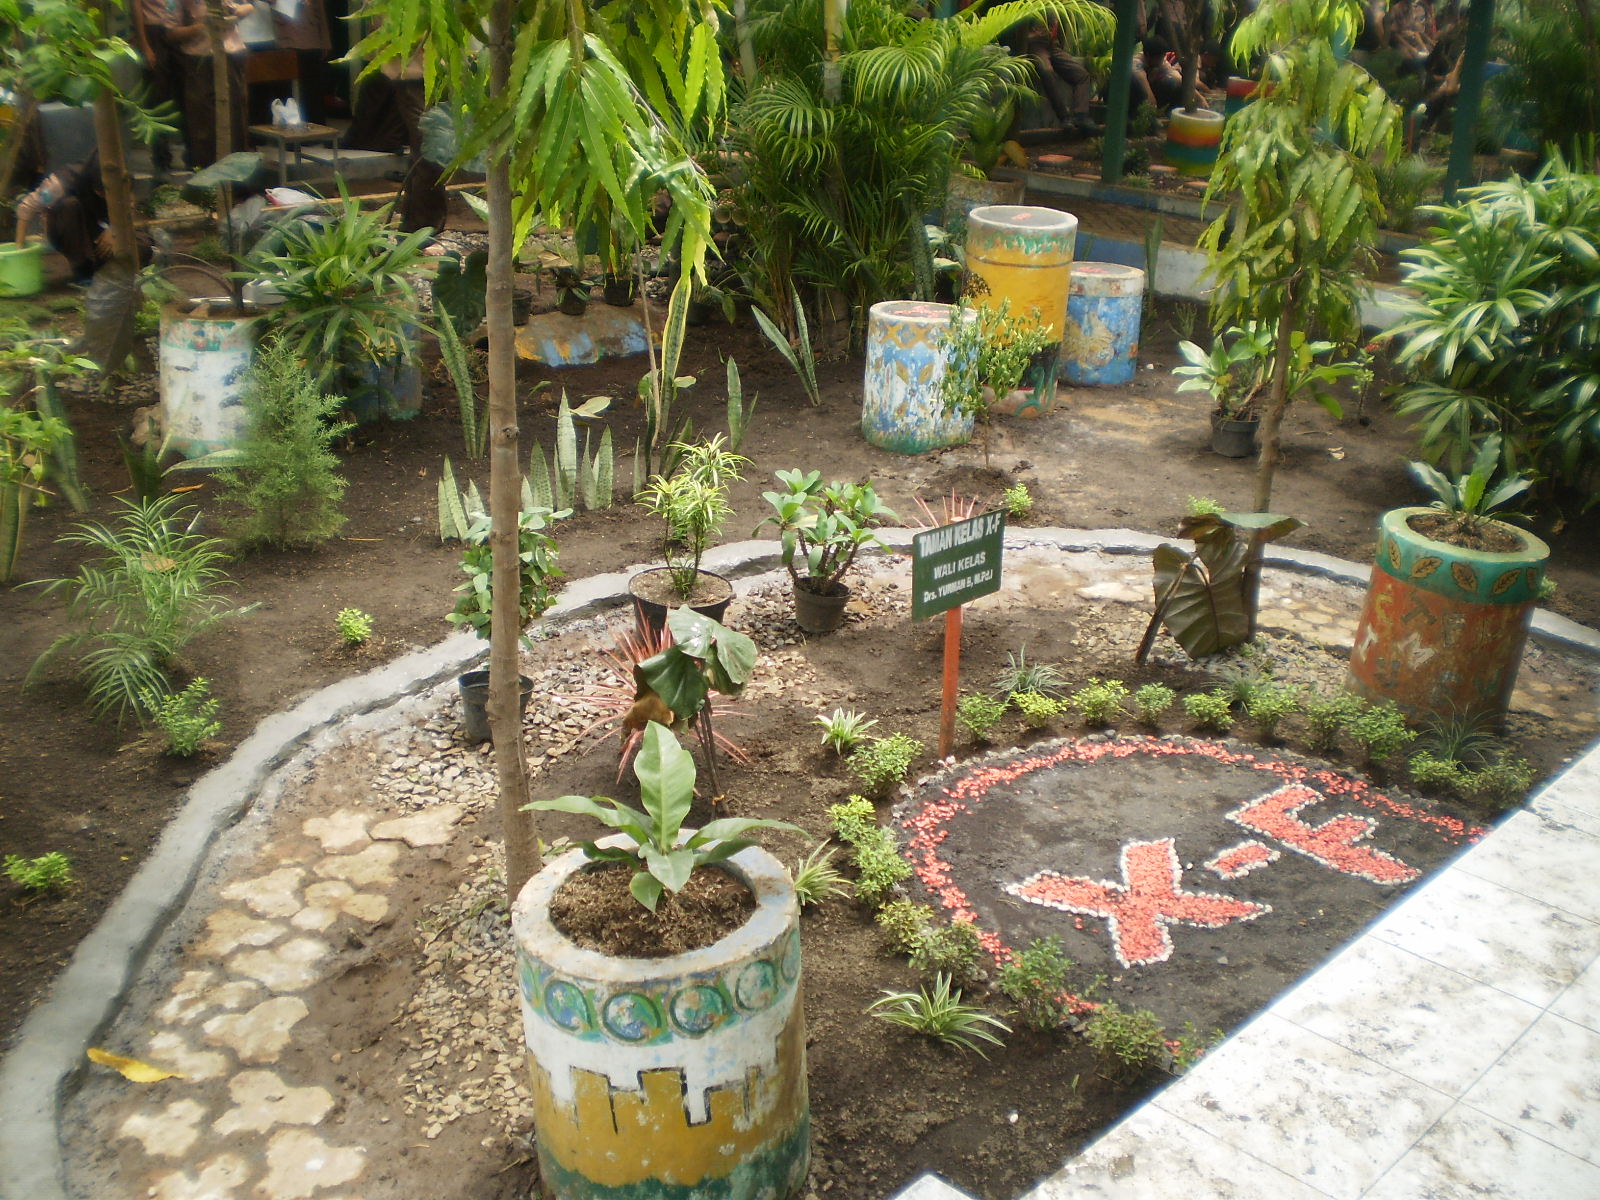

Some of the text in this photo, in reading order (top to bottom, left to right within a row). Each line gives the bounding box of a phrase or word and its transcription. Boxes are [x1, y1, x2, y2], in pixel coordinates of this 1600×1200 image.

[919, 528, 953, 558] TAMAN
[953, 519, 984, 546] KELAS
[933, 552, 986, 580] WALI KELAS
